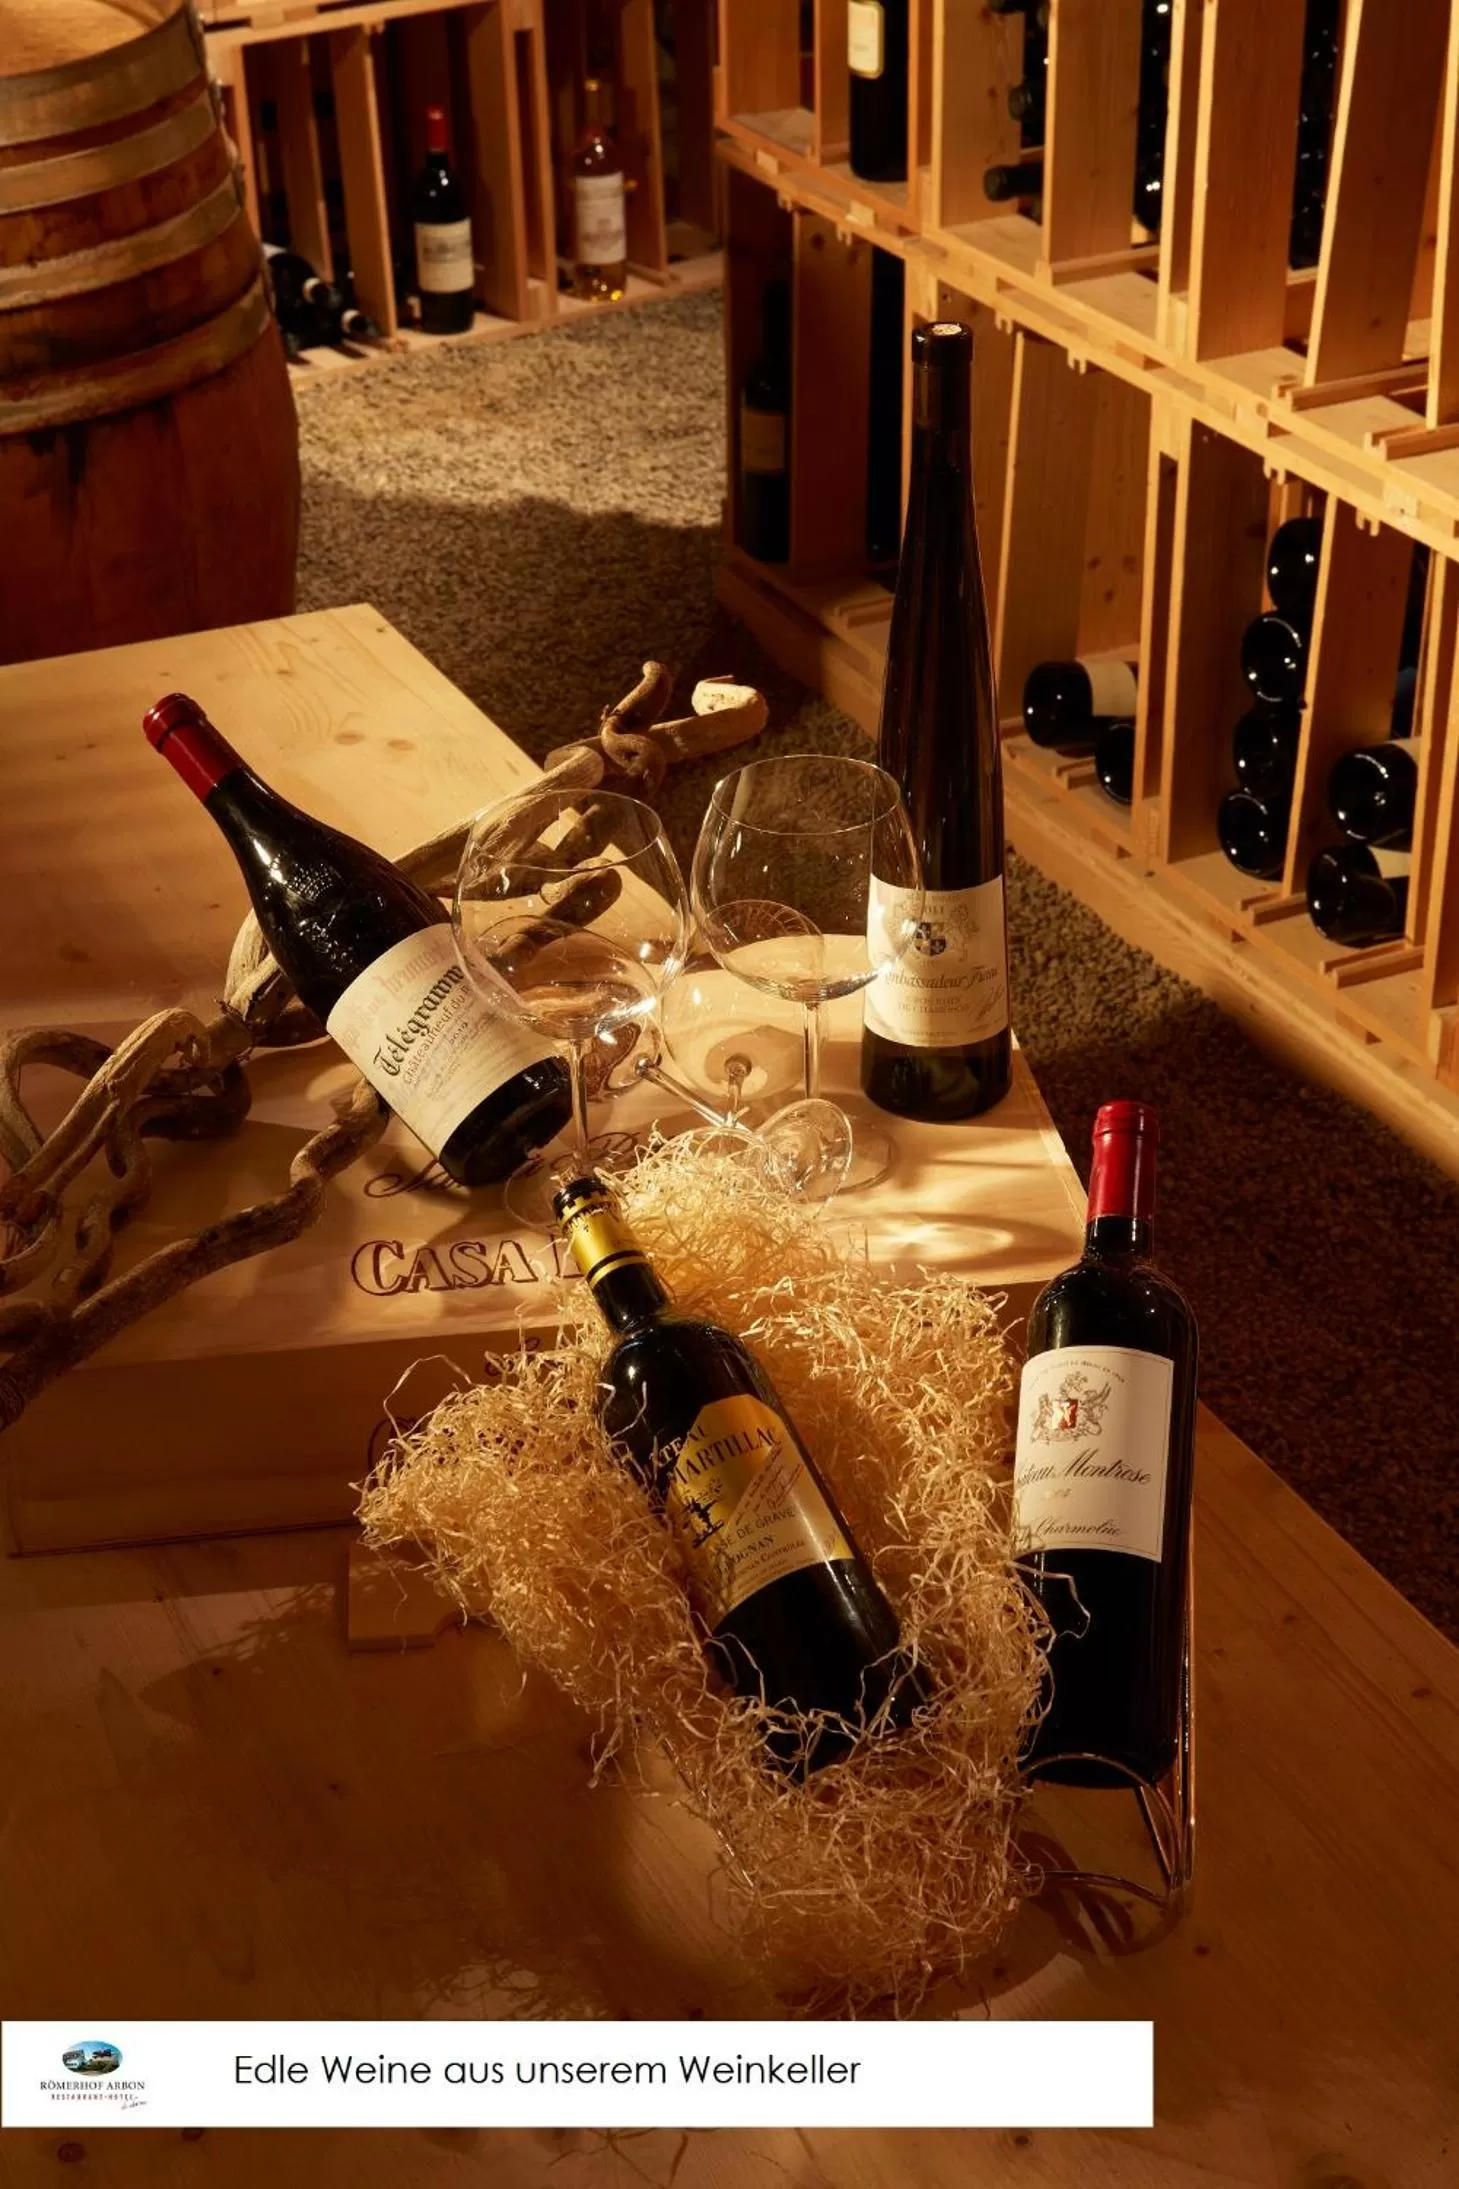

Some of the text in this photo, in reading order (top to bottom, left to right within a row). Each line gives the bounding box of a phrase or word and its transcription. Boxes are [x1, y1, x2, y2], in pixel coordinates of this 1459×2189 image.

[373, 963, 466, 1077] Télégramm
[351, 1239, 538, 1297] CASA
[1063, 1447, 1152, 1486] Montrose
[756, 1507, 799, 1530] GRAVE
